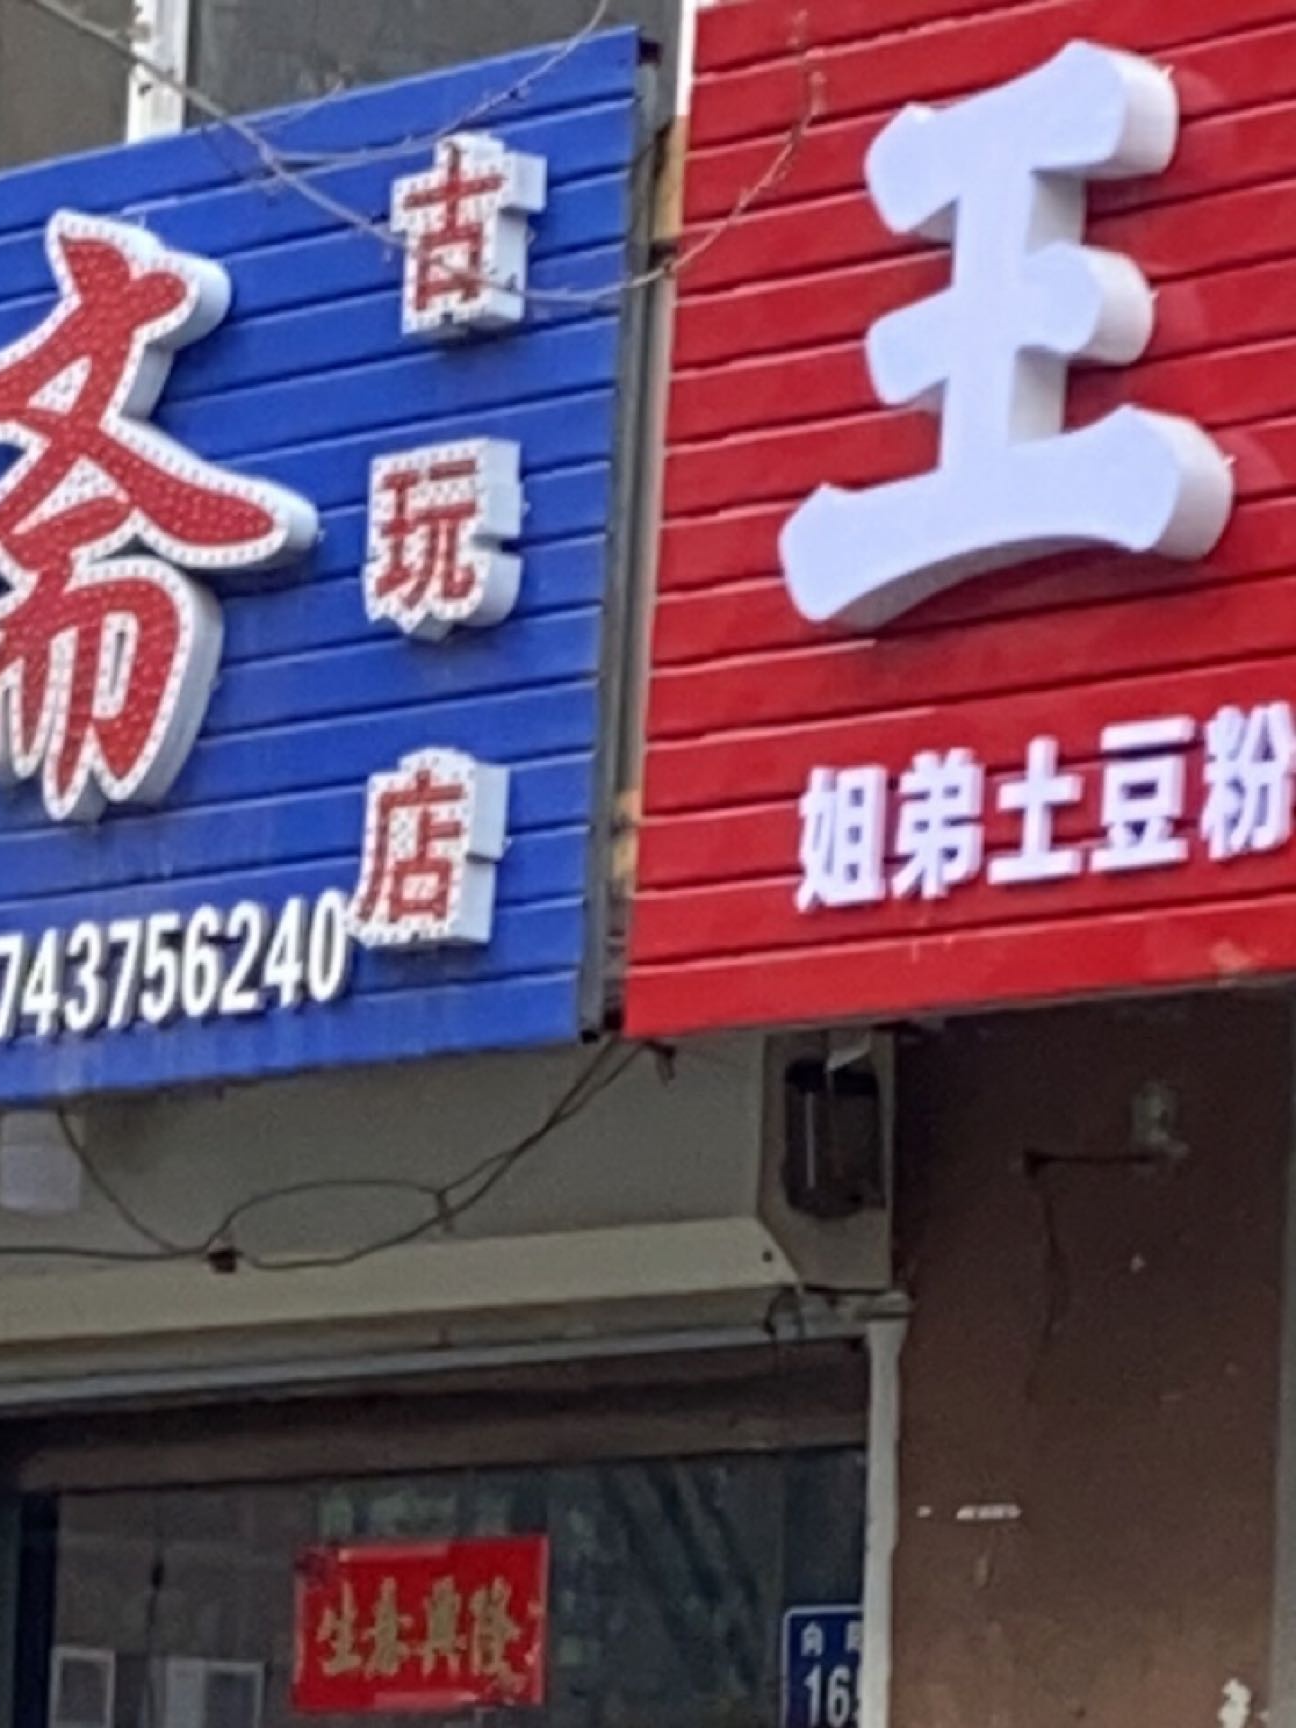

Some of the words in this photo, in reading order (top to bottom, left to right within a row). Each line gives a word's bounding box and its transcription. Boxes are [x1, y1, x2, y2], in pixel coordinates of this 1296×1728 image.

[779, 40, 1233, 625] 王
[346, 131, 546, 949] 古玩店
[795, 702, 1295, 912] 姐弟土豆粉
[805, 1664, 862, 1728] 16
